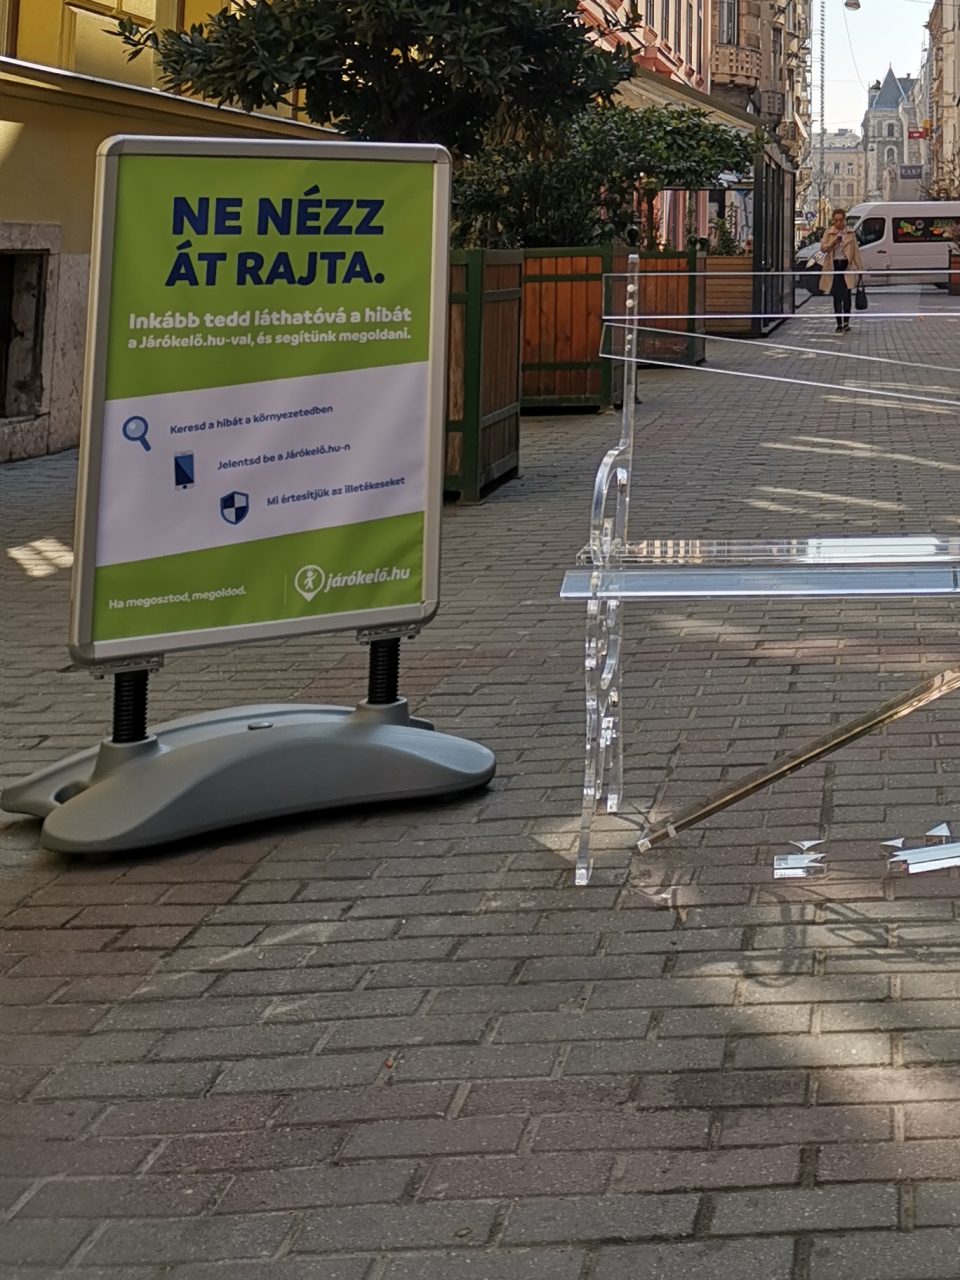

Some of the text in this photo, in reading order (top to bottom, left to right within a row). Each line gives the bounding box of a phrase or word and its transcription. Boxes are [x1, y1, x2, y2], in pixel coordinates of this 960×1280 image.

[172, 184, 385, 235] NE NÉZZ
[165, 239, 385, 286] ÁT RAJTA.
[129, 305, 412, 329] Inkább tedd láthatóvá a hibát
[128, 327, 412, 348] a Járókelő.hu-val, és segítünk megoldani.
[170, 421, 206, 435] Keresd
[208, 422, 215, 430] a
[216, 416, 243, 429] hibát
[253, 405, 333, 424] környezetedben
[217, 443, 351, 470] Jelentsd be a Járókelő.hu-n
[267, 477, 406, 506] Mi értesítjük az illetékeseket
[323, 566, 411, 593] járókelő.hu
[109, 585, 247, 609] Ha megosztod, megoldod.
